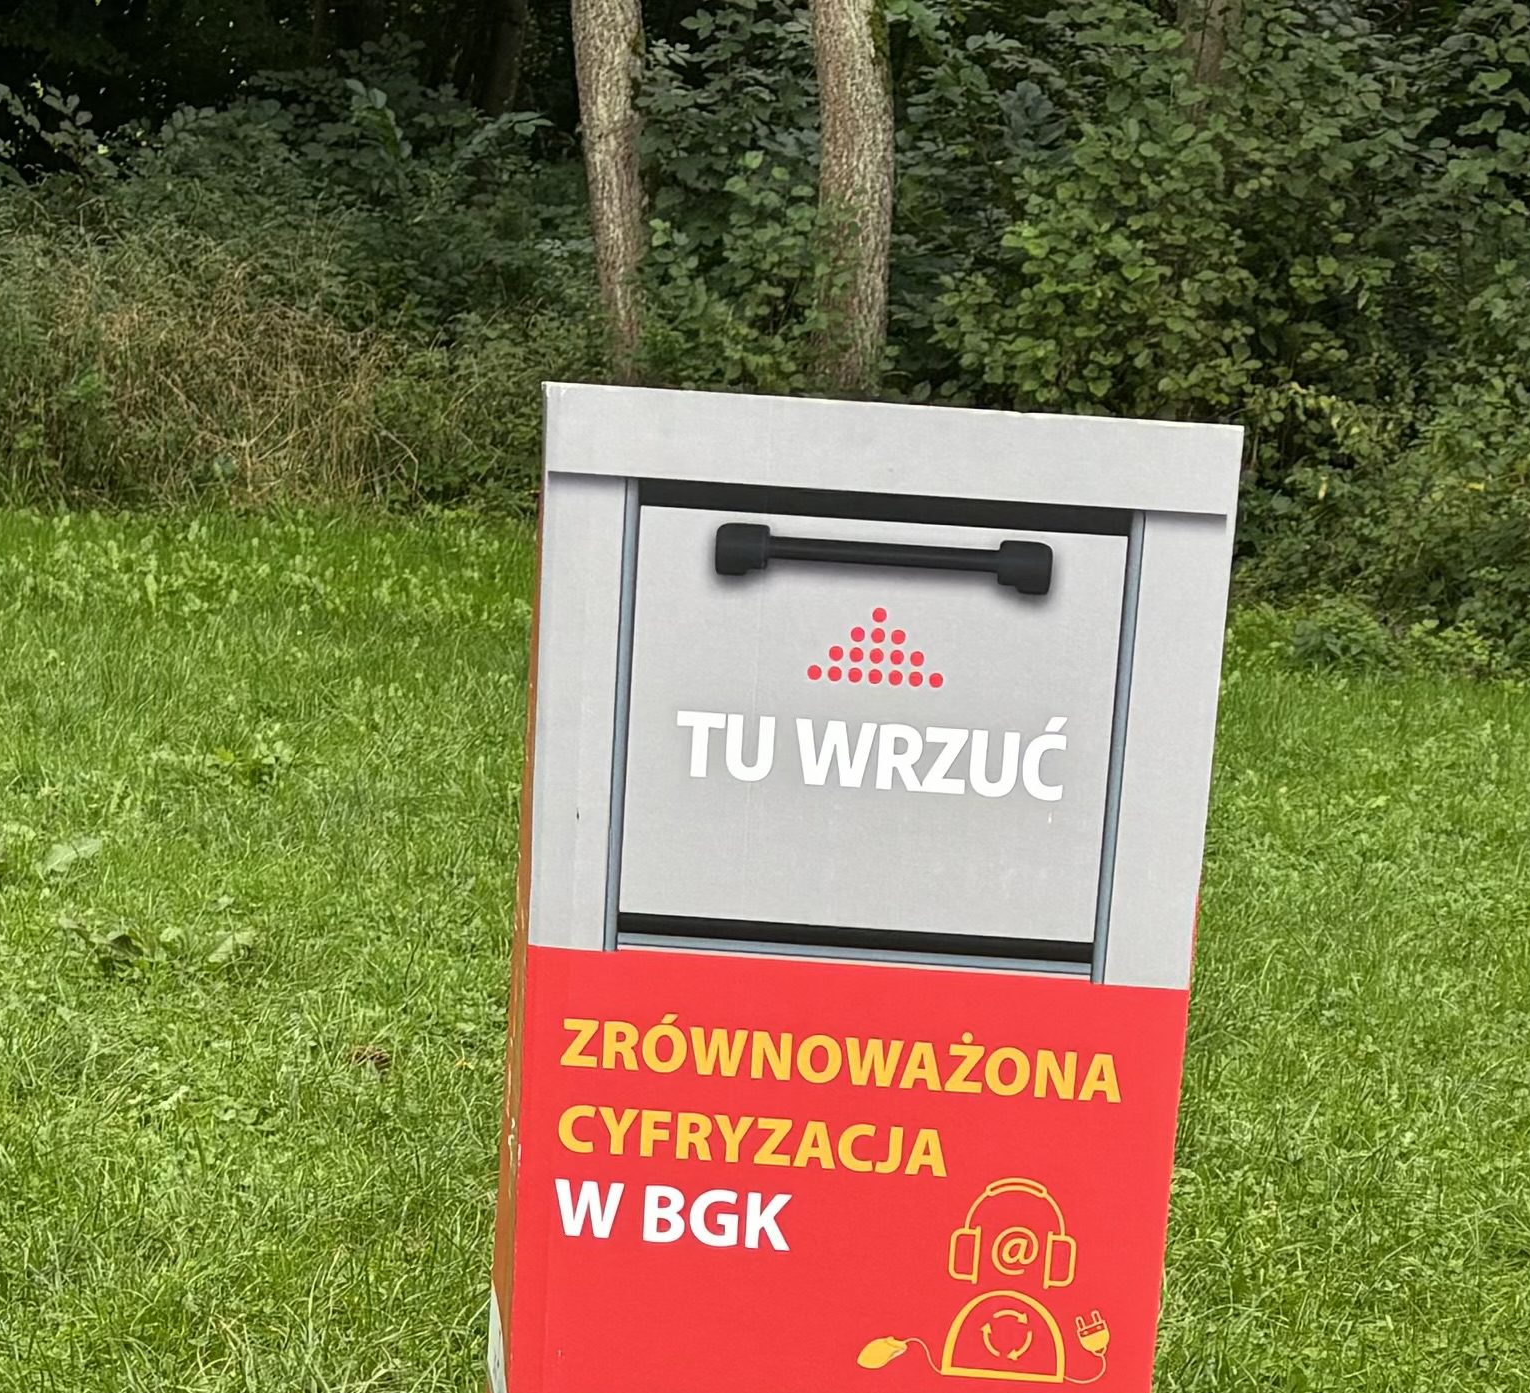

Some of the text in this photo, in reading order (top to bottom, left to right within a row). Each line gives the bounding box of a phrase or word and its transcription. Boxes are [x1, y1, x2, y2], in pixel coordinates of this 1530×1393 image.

[676, 710, 1069, 801] TU WRZUĆ
[559, 1013, 1122, 1103] ZRÓWNOWAŻONA
[557, 1105, 947, 1177] CYFRYZACJA
[554, 1178, 793, 1251] W BGK
